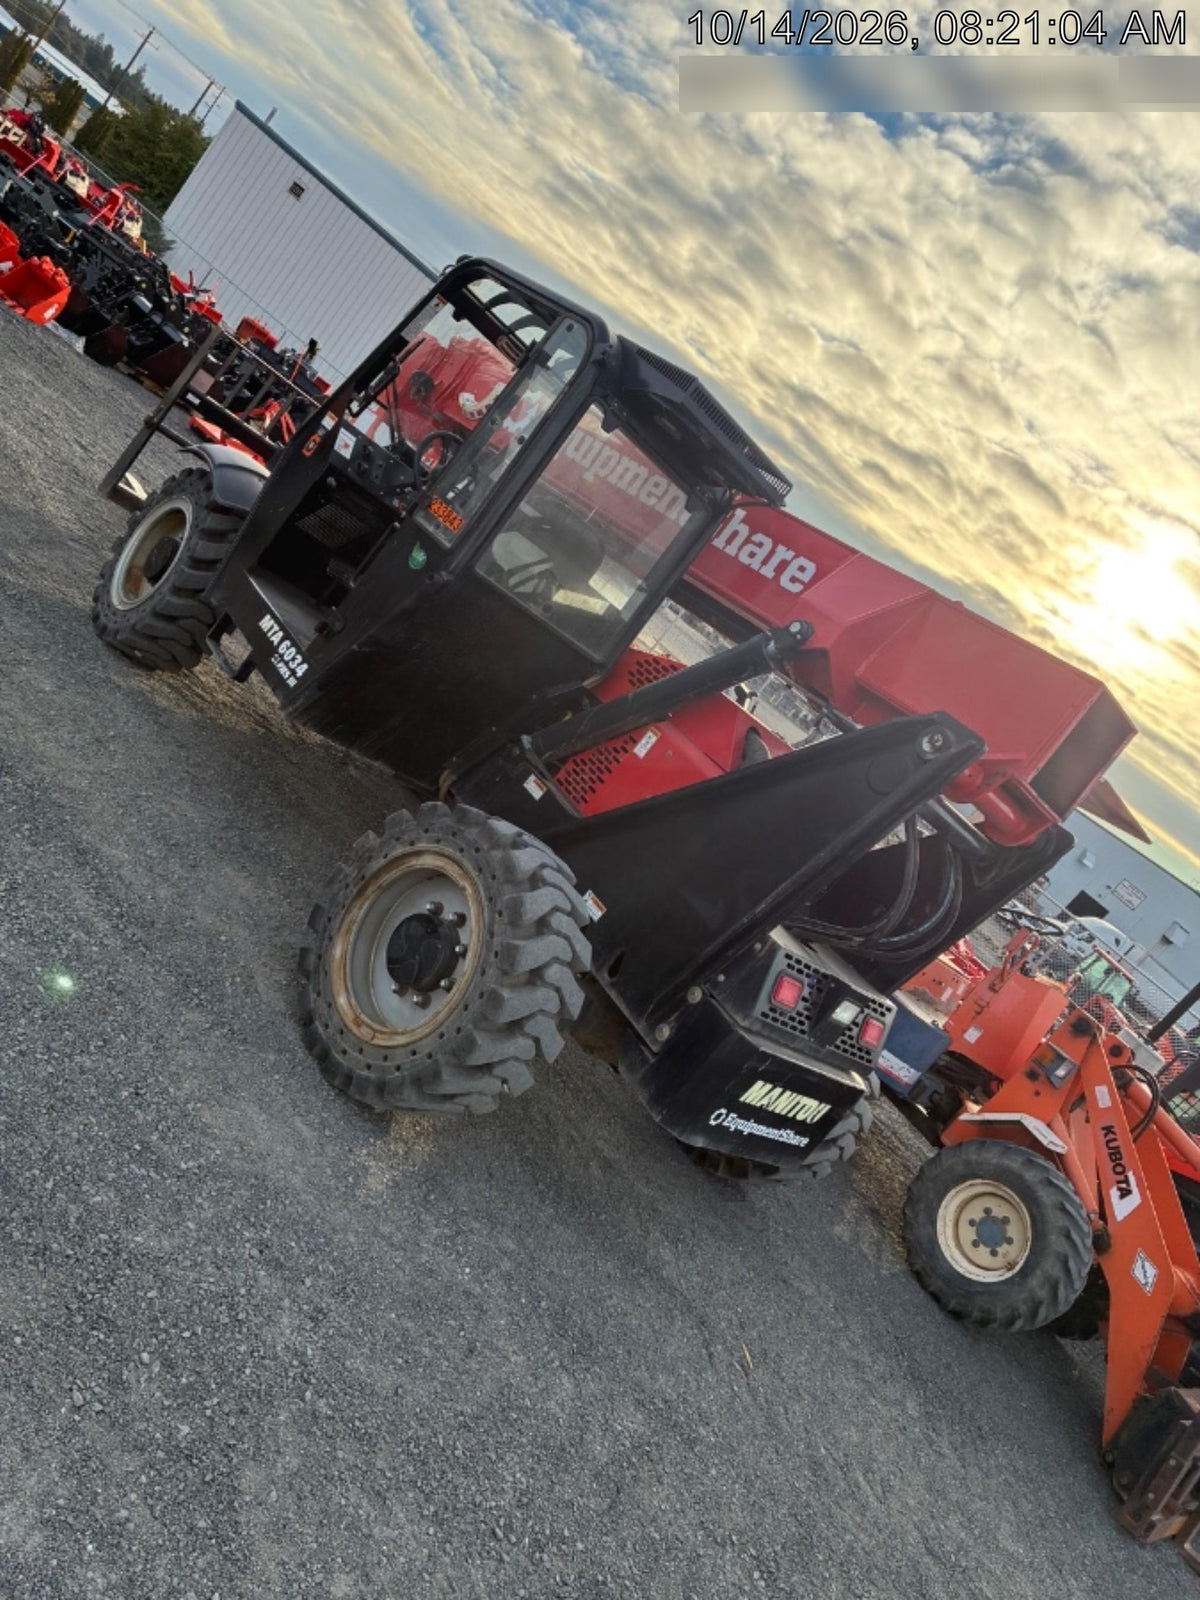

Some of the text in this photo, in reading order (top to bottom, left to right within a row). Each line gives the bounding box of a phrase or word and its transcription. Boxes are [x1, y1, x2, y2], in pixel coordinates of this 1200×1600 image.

[562, 431, 817, 594] uipmen hare
[258, 613, 284, 647] MTA
[278, 639, 309, 678] 6034
[738, 1079, 833, 1125] MANITOU
[1101, 1124, 1134, 1201] KUBOTA
